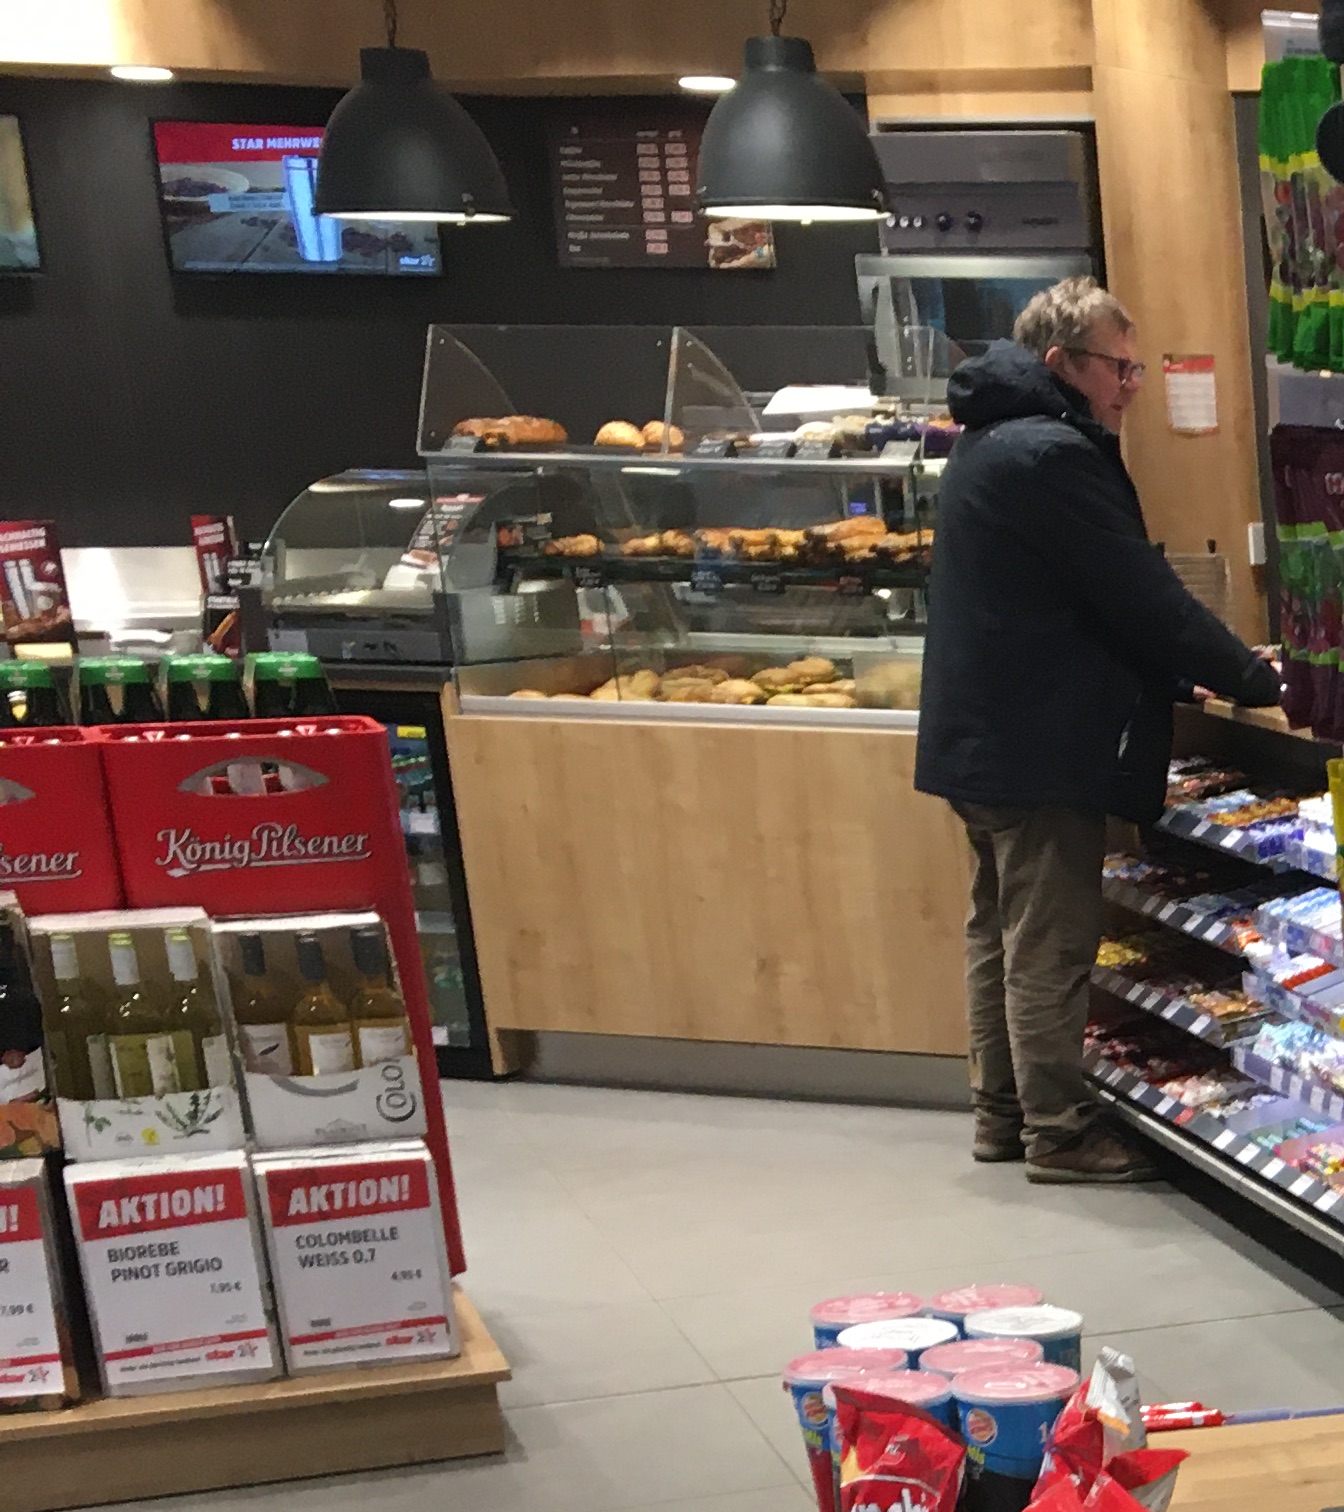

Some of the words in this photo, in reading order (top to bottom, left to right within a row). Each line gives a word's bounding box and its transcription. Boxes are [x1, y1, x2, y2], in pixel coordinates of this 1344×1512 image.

[232, 137, 263, 150] STAR
[155, 827, 249, 870] König
[250, 821, 370, 862] Pilsener
[98, 1184, 225, 1229] AKTION!
[288, 1175, 410, 1217] AKTION!
[296, 1227, 399, 1251] COLOMBELLE
[107, 1241, 180, 1263] BIOREBE
[298, 1251, 349, 1268] WEISS
[111, 1264, 160, 1282] PINOT
[165, 1257, 223, 1276] GRIGIO
